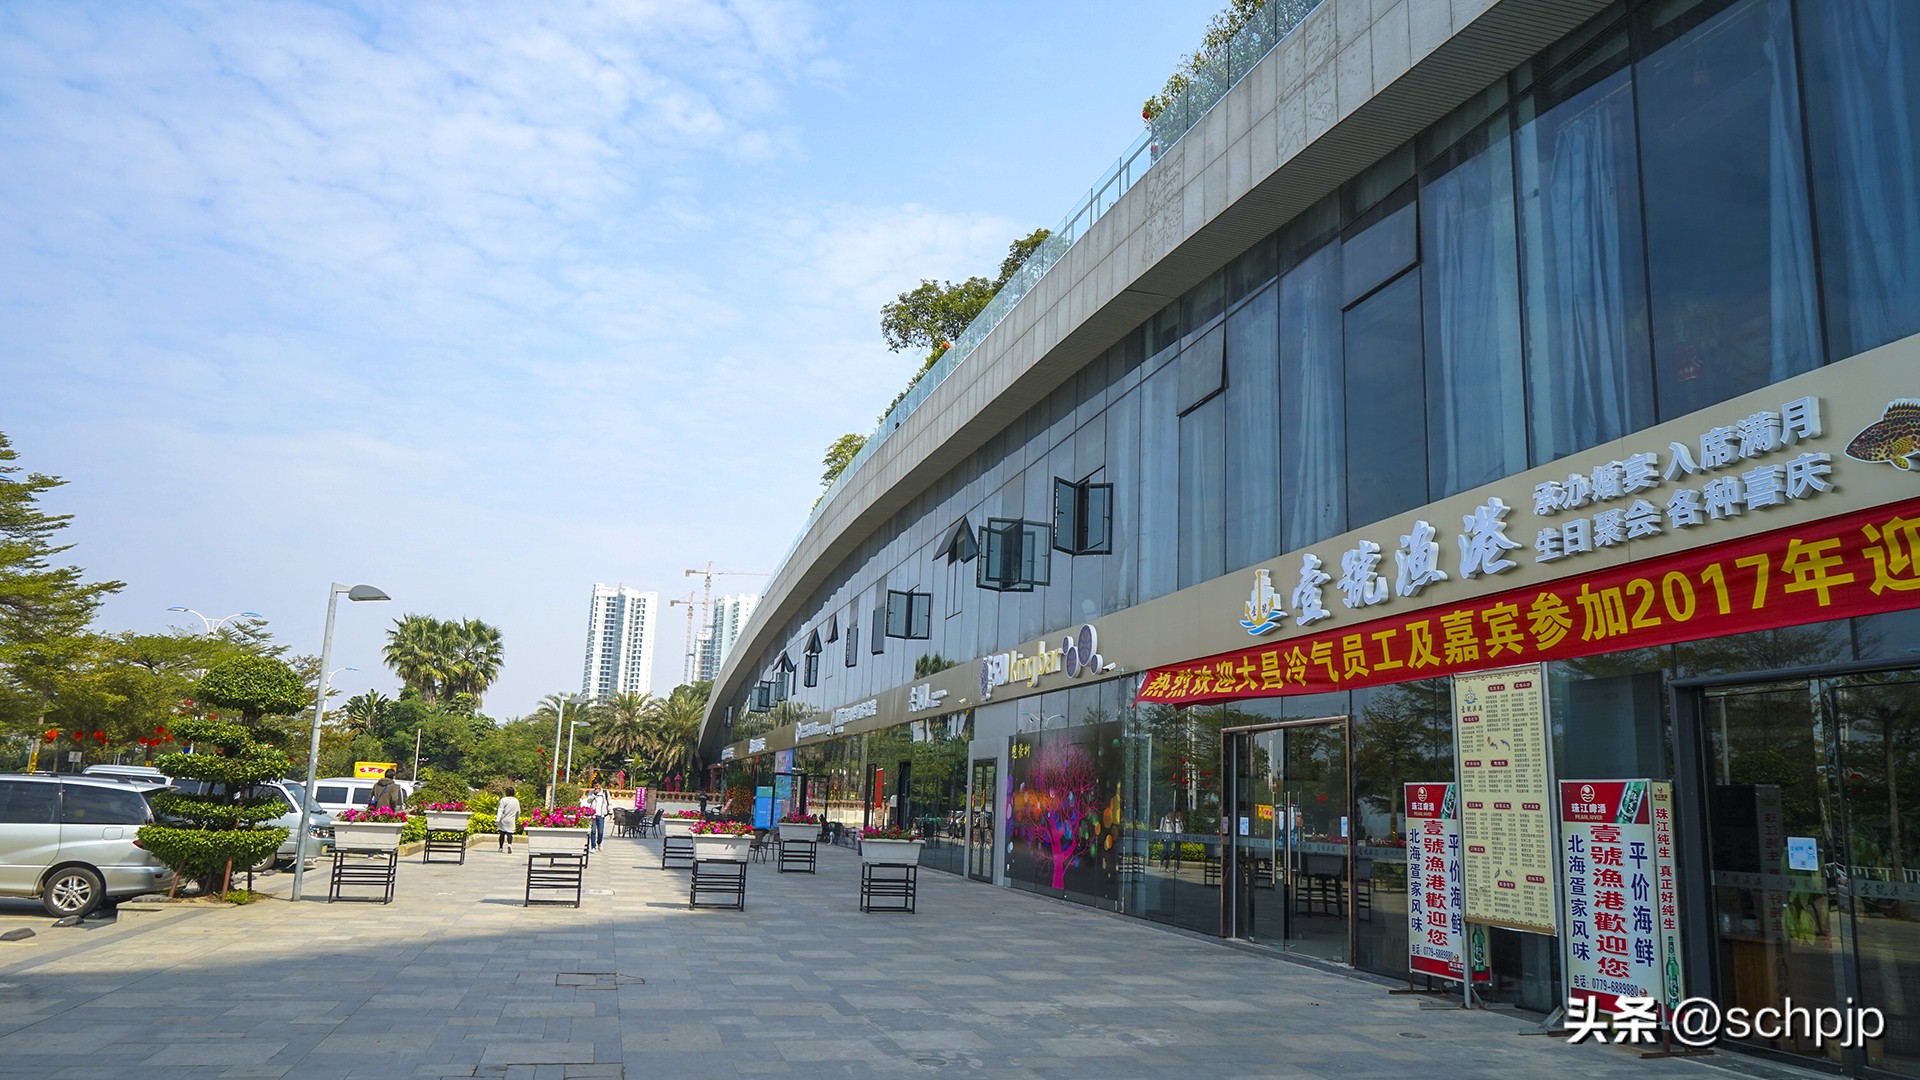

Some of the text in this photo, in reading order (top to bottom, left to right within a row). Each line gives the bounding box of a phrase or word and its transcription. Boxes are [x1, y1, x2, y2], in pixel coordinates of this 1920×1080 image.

[1571, 803, 1607, 814] 珠江啤酒
[1590, 824, 1630, 979] 壹號漁港歡迎您
[1629, 842, 1655, 967] 平价海鲜
